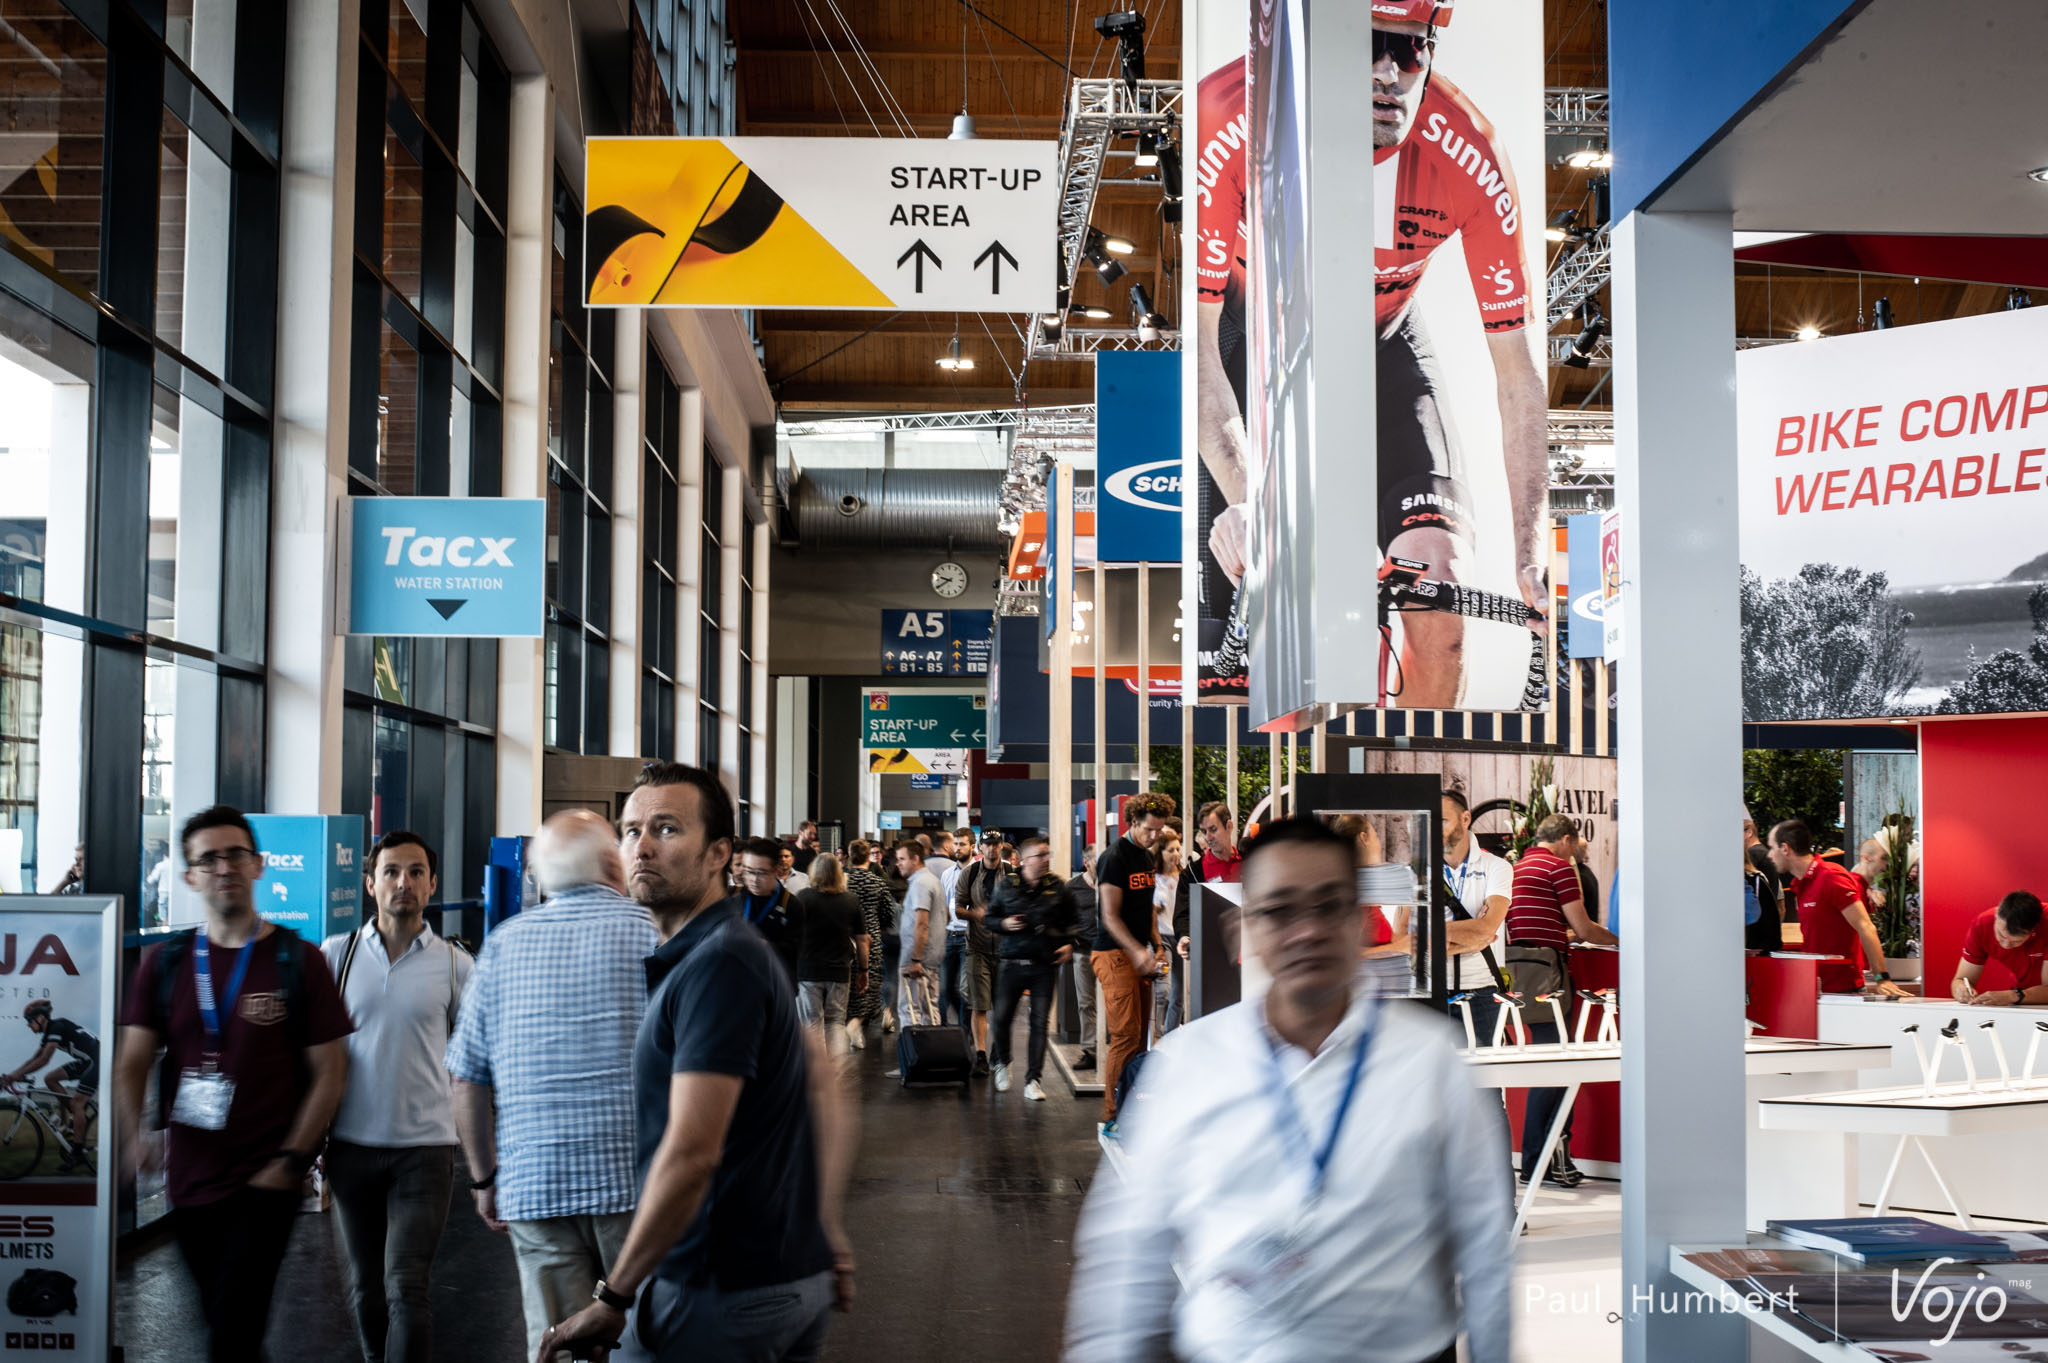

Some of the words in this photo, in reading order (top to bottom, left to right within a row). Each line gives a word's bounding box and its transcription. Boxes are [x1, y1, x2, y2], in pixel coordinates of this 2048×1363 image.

[890, 166, 1042, 191] START-UP
[1421, 112, 1518, 236] Sunweb
[889, 204, 970, 227] AREA
[1398, 205, 1439, 219] CRAFT
[1422, 229, 1449, 240] DSM
[1481, 294, 1530, 311] Sunweb
[1775, 405, 1883, 457] BIKE
[1900, 384, 2048, 442] COMP
[1775, 448, 2048, 516] WEARABLE
[381, 526, 517, 568] Tacx
[394, 577, 442, 590] WATER
[445, 577, 503, 590] STATION
[898, 612, 945, 638] A5
[900, 650, 917, 661] A6
[926, 650, 943, 661] A7
[900, 662, 916, 673] B1
[927, 662, 944, 673] B5
[869, 719, 938, 731] START-UP
[869, 731, 907, 743] AREA
[259, 911, 309, 921] aterstation
